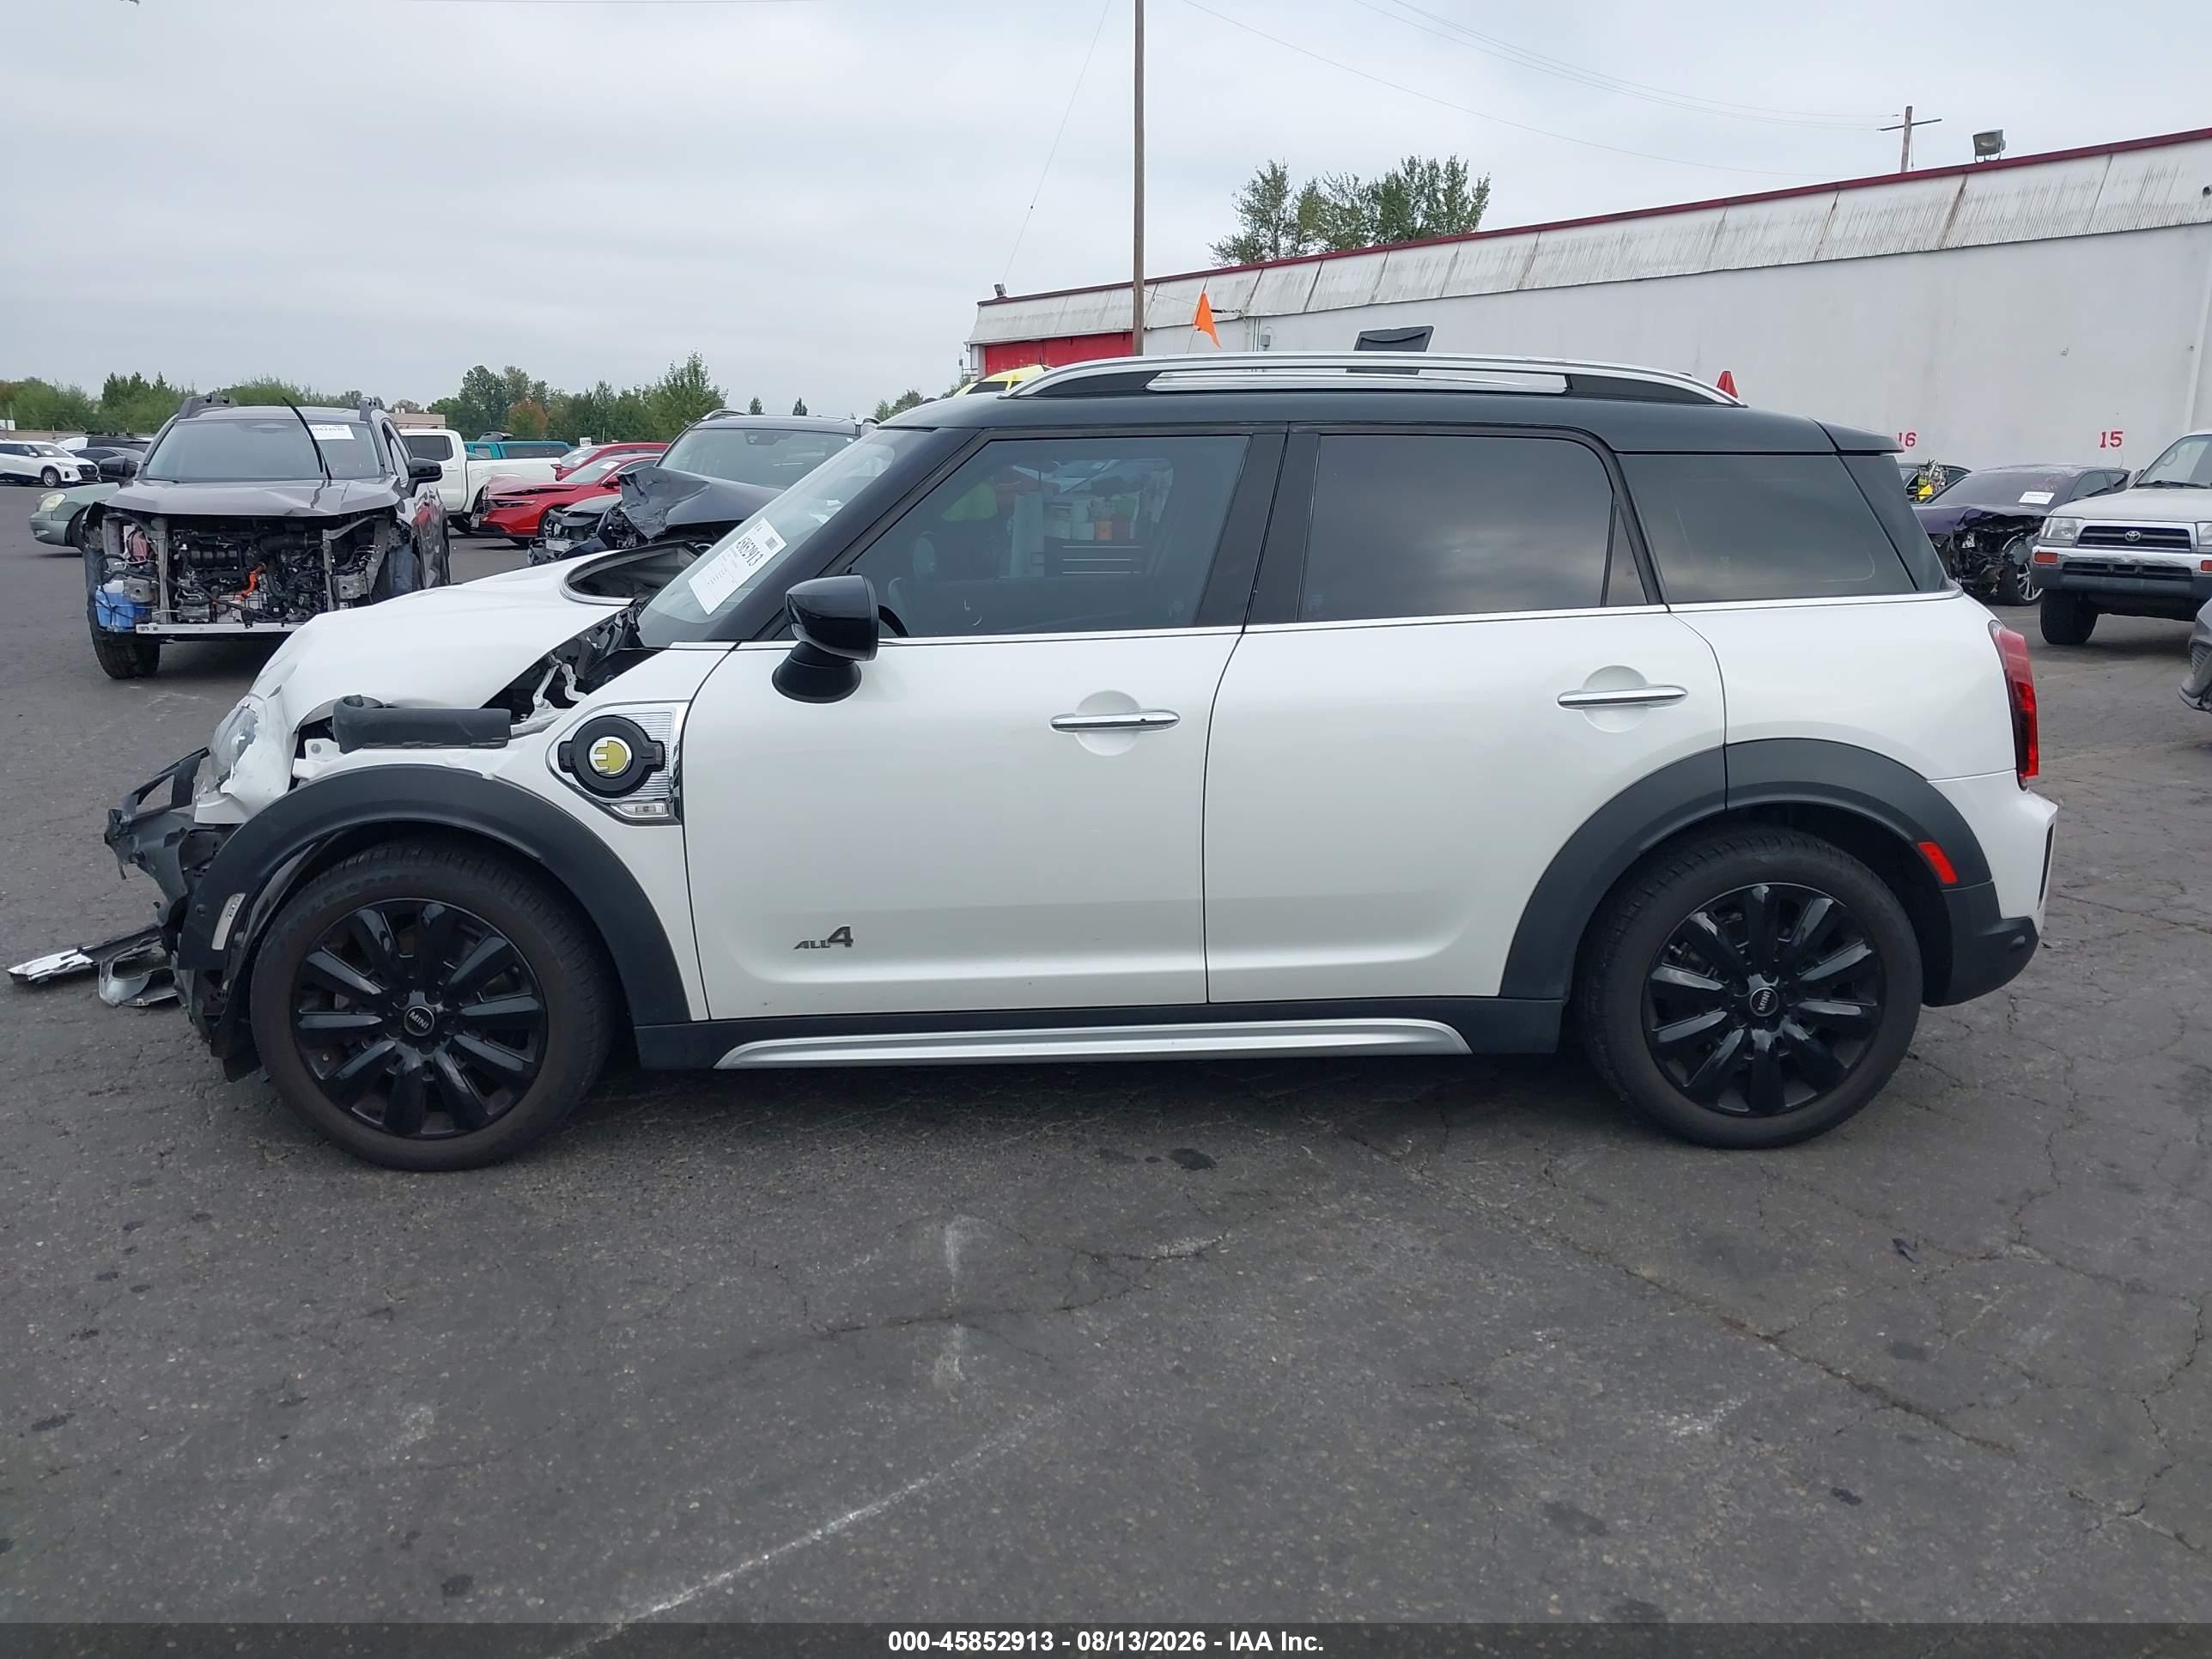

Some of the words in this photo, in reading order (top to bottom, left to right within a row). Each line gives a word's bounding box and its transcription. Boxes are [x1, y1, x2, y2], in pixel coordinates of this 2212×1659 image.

[1899, 432, 1917, 447] 16
[2100, 430, 2124, 448] 15
[1758, 990, 1771, 1012] MINI
[408, 1010, 430, 1030] MINI
